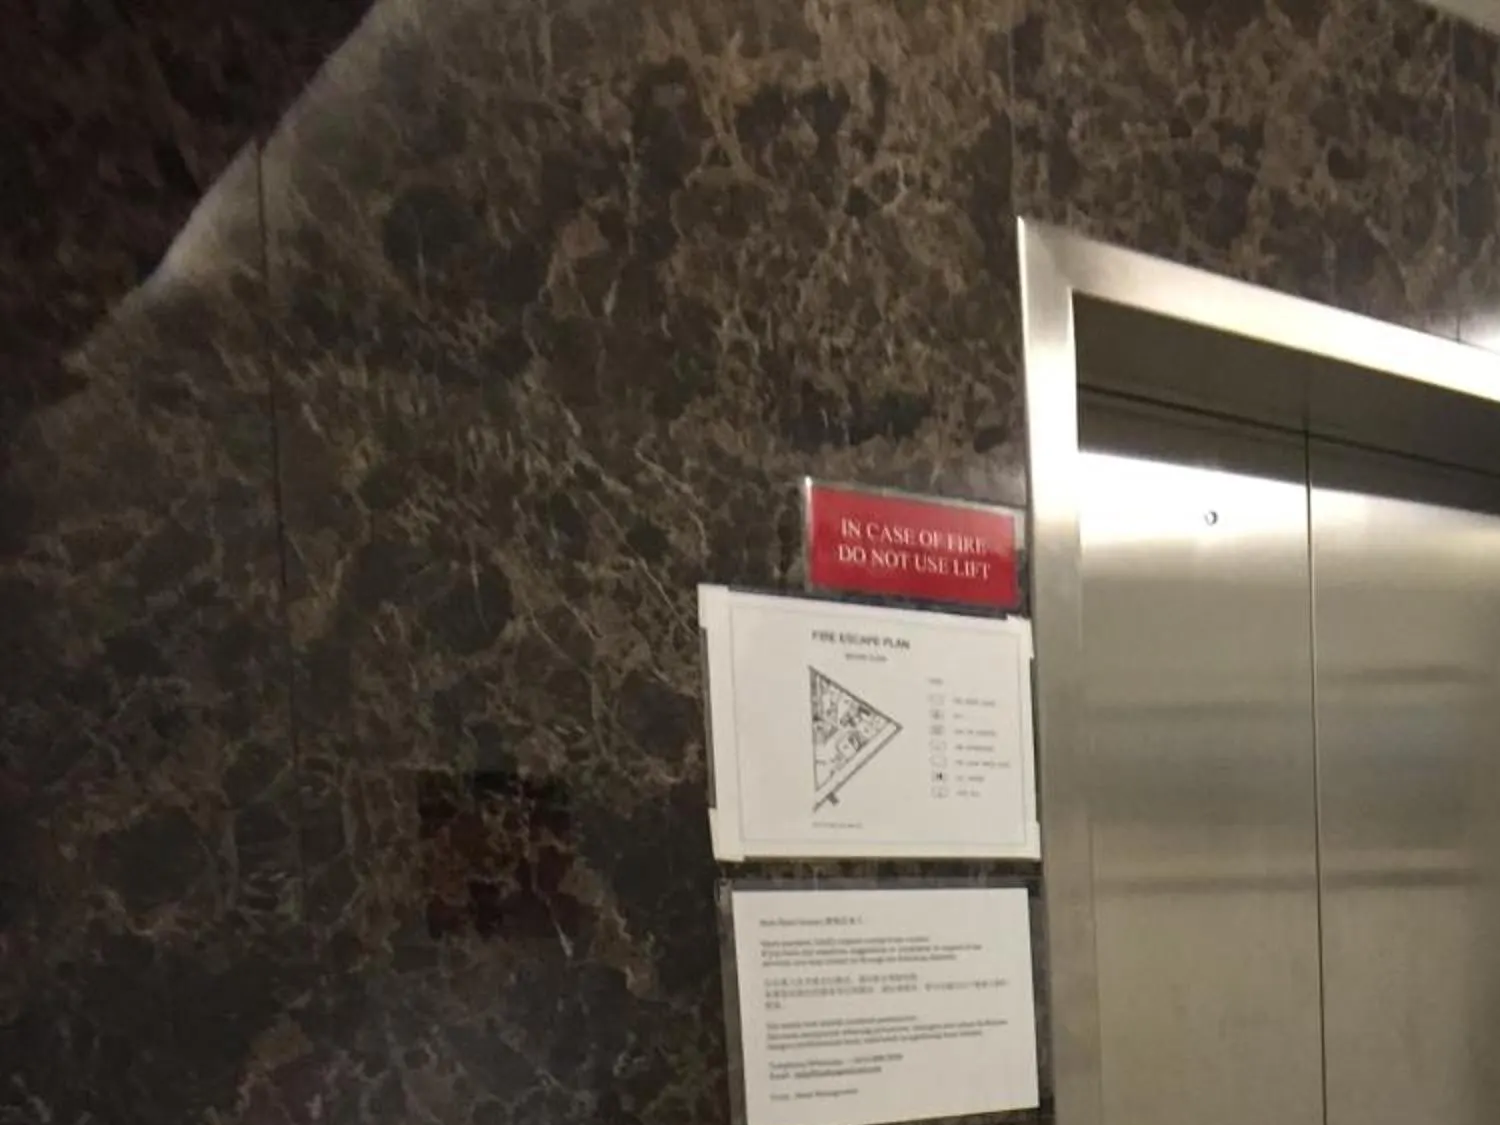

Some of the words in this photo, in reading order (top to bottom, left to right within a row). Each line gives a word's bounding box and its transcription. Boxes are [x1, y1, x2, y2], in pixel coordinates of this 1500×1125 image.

[841, 517, 861, 538] IN
[866, 521, 914, 545] CASE
[919, 529, 941, 548] OF
[948, 533, 988, 555] FIRE
[838, 543, 866, 562] DO
[871, 549, 909, 569] NOT
[914, 553, 948, 575] USE
[953, 558, 990, 580] LIFT
